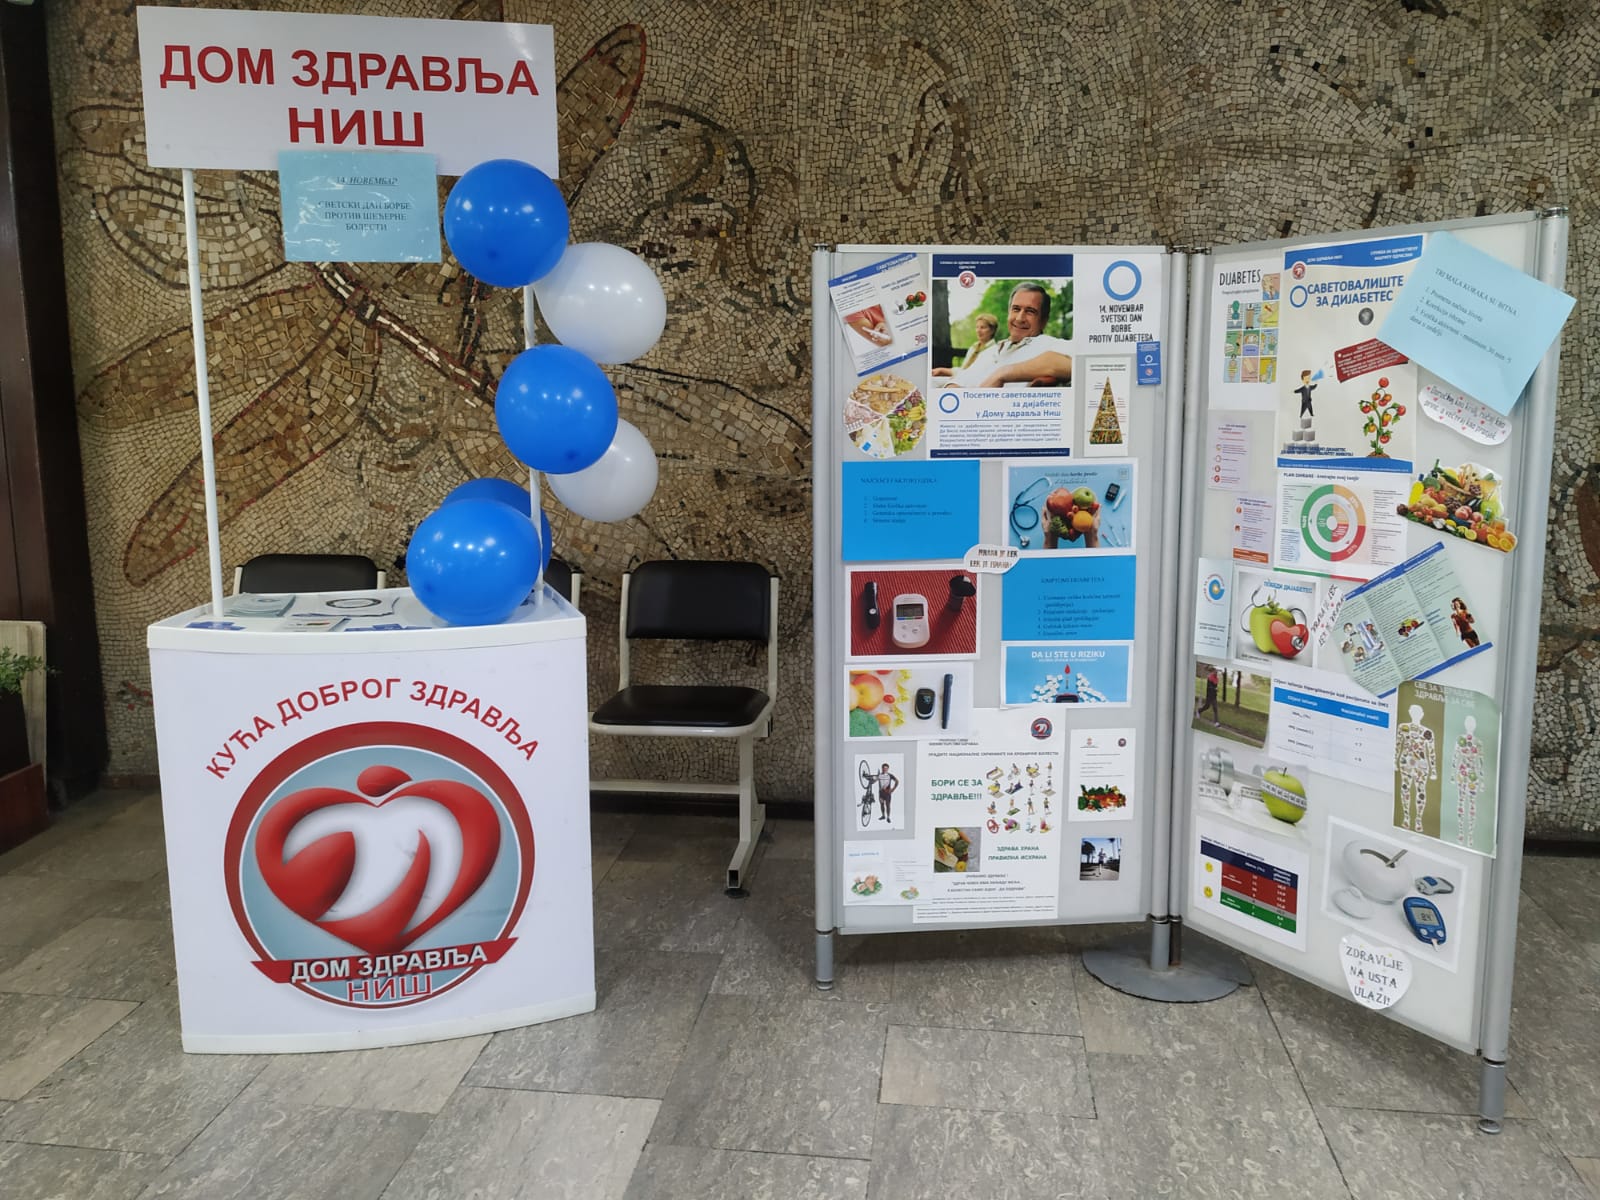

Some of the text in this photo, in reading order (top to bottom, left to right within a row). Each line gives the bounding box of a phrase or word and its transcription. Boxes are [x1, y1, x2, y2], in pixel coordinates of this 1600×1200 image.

[160, 45, 540, 95] ДОМ ЗДРАВЉА
[289, 107, 425, 147] НИШ
[362, 202, 382, 210] ДАН
[384, 202, 411, 210] БОРБЕ
[325, 212, 361, 220] ПРОТИВ
[346, 223, 387, 231] БОЛЕСТИ
[1307, 275, 1404, 294] САВЕТОВАЛИШТЕ
[1316, 290, 1393, 308] ЗА ДИЈАБЕТЕС
[1109, 304, 1144, 313] NOVEMBAR
[1101, 314, 1143, 323] SVETSKI DAN
[1111, 324, 1132, 333] BORBE
[1089, 333, 1154, 343] PROTIV DIJABETESA
[1022, 400, 1062, 408] дијабетес
[982, 410, 1004, 418] Дому
[1006, 410, 1041, 418] здравља
[1078, 650, 1106, 658] RIZIKU
[205, 677, 540, 779] КУЋА ДОБРОГ ЗДРАВЉА
[931, 779, 955, 787] БОРИ
[930, 793, 982, 801] ЗДРАВЉЕ!!!
[290, 944, 488, 982] ДОМ ЗДРАВЉА
[1346, 946, 1404, 972] ZDRAVLJE
[1350, 965, 1397, 989] NA USTA
[346, 974, 433, 1002] НИШ
[1354, 985, 1391, 1006] ULAZI!
